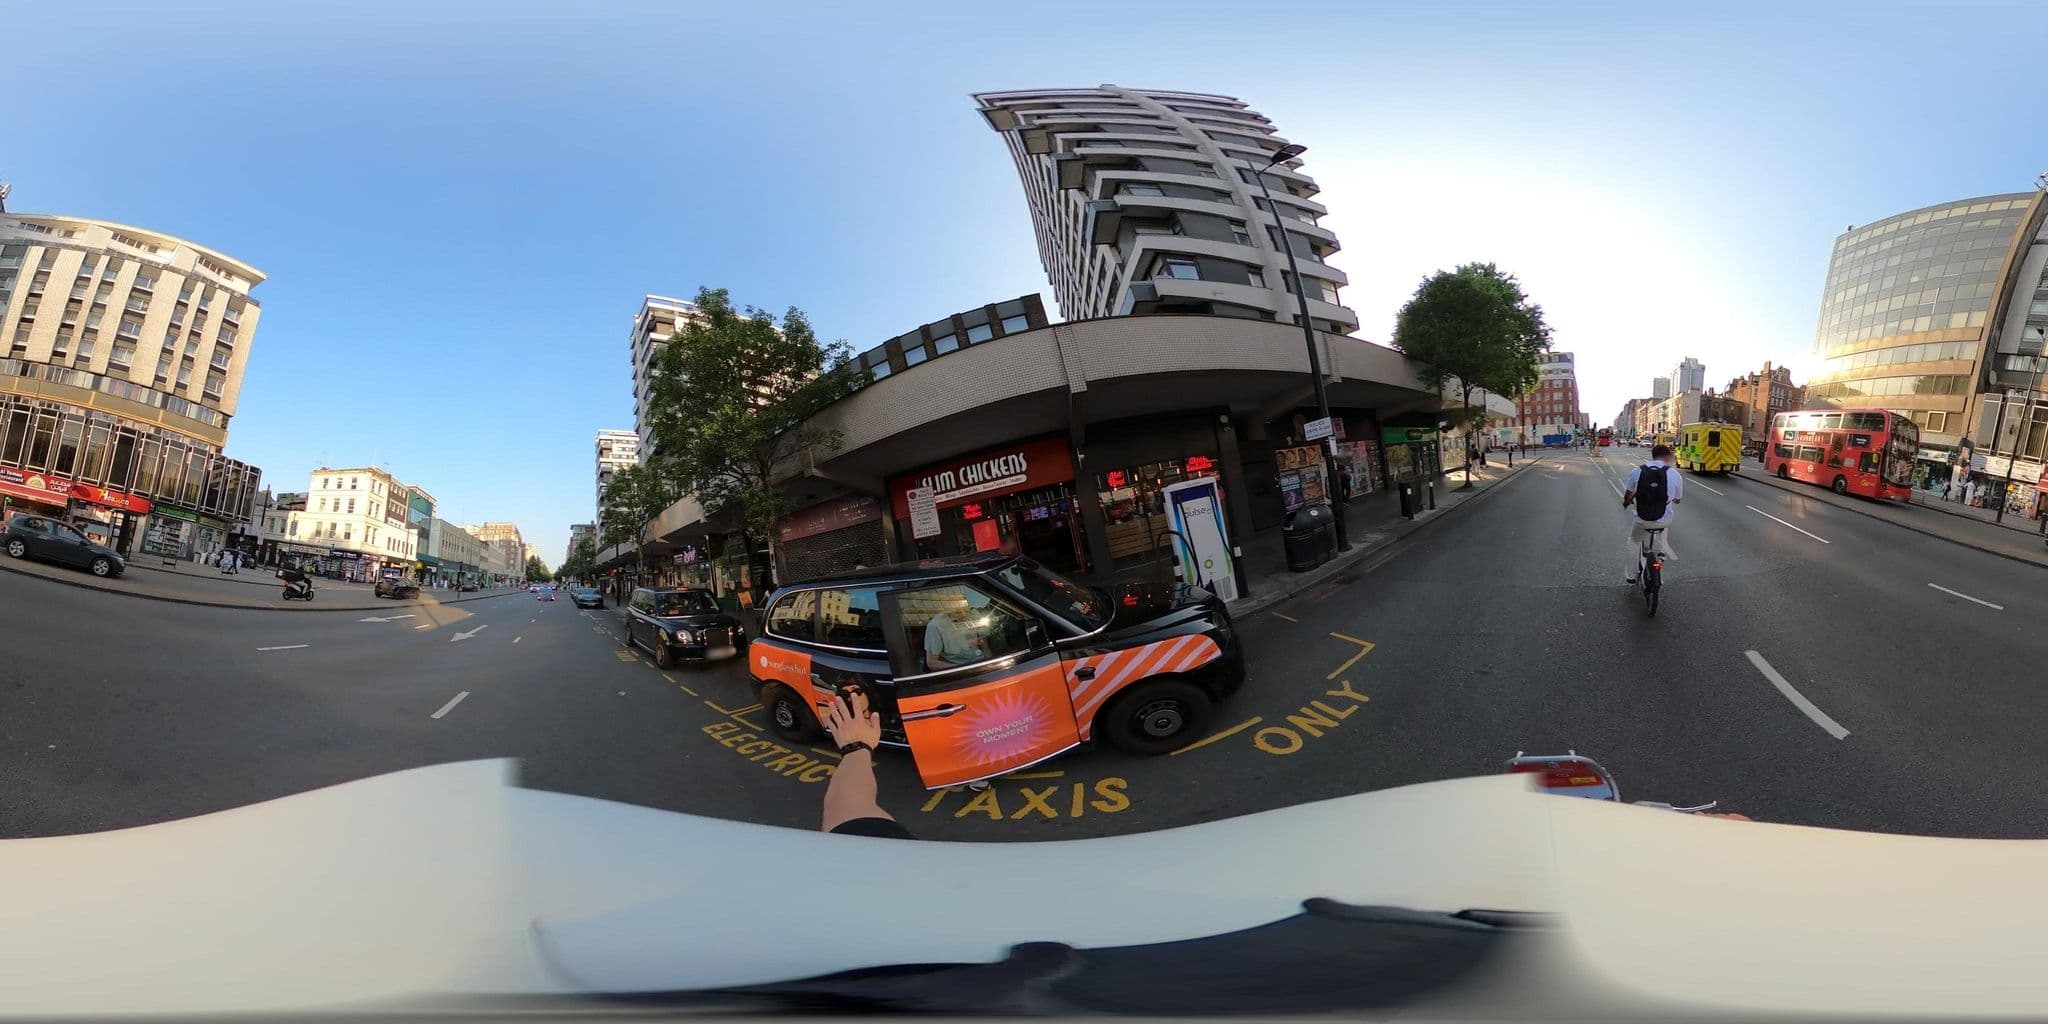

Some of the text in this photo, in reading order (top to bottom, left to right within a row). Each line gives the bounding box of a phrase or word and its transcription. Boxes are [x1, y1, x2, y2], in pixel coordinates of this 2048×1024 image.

[959, 453, 1027, 486] CHICKENS
[976, 715, 1033, 738] OWN YOUR
[983, 724, 1029, 744] MOMENT
[1253, 680, 1370, 756] ONLY
[702, 722, 837, 783] ELECTRIC
[921, 777, 1130, 820] TAXIS
